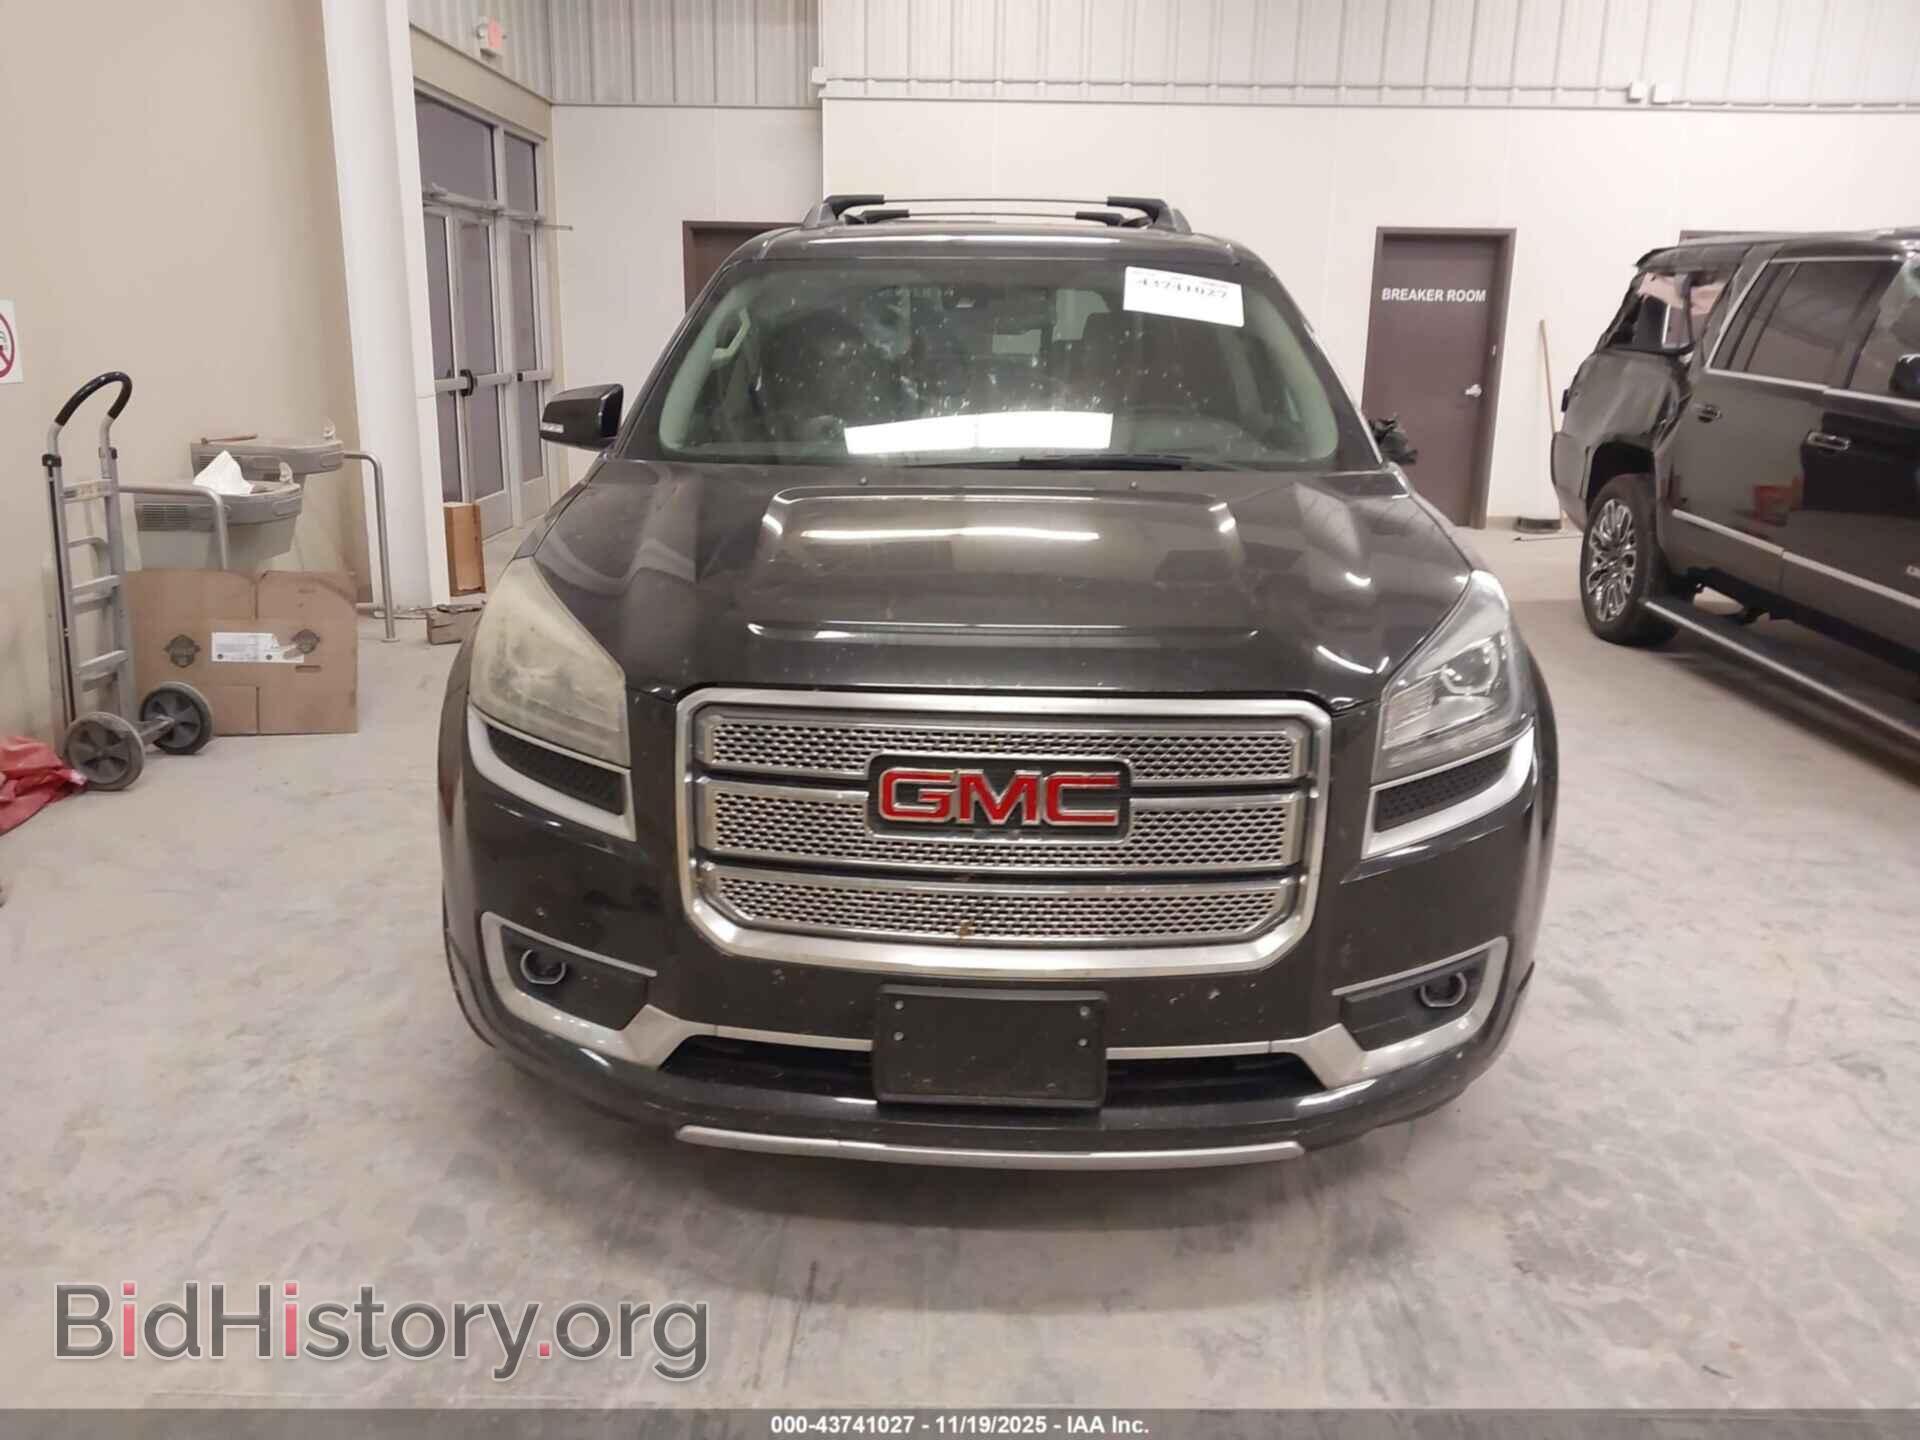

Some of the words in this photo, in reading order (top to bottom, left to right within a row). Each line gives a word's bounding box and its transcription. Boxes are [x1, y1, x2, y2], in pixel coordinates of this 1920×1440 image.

[1382, 287, 1444, 301] BREAKER
[1447, 288, 1487, 302] ROOM
[878, 767, 1121, 827] GMC
